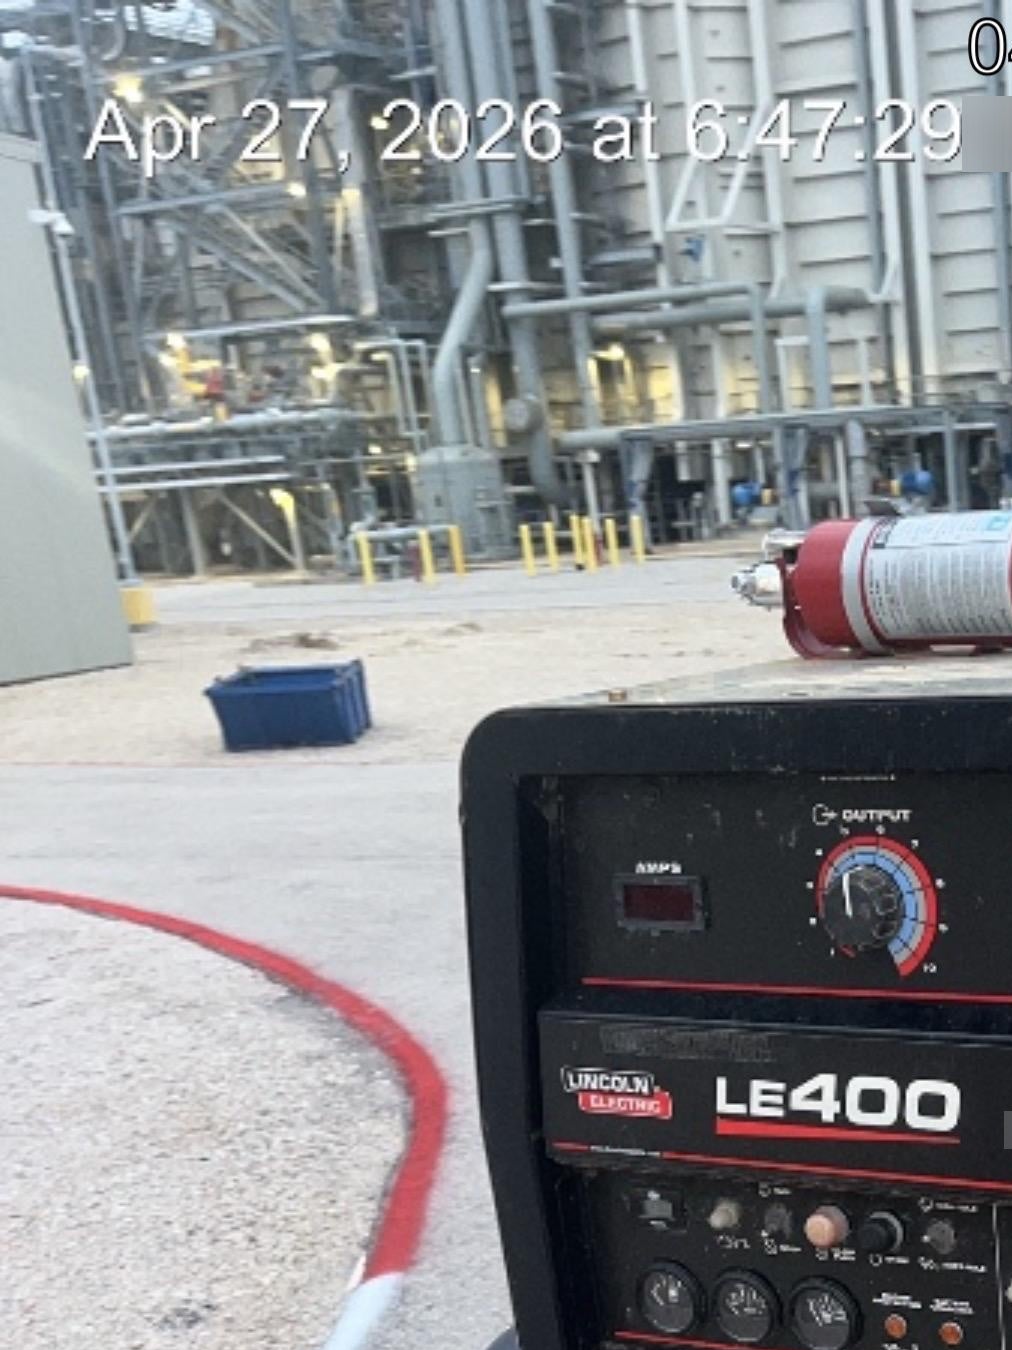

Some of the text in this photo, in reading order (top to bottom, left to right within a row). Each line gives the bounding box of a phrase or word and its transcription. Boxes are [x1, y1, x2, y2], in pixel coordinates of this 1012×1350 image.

[842, 808, 912, 822] OUTPUT
[635, 861, 682, 874] AMPS
[568, 1071, 650, 1094] LINCOLN
[589, 1094, 661, 1113] ELECTRIC
[715, 1072, 961, 1133] LE400
